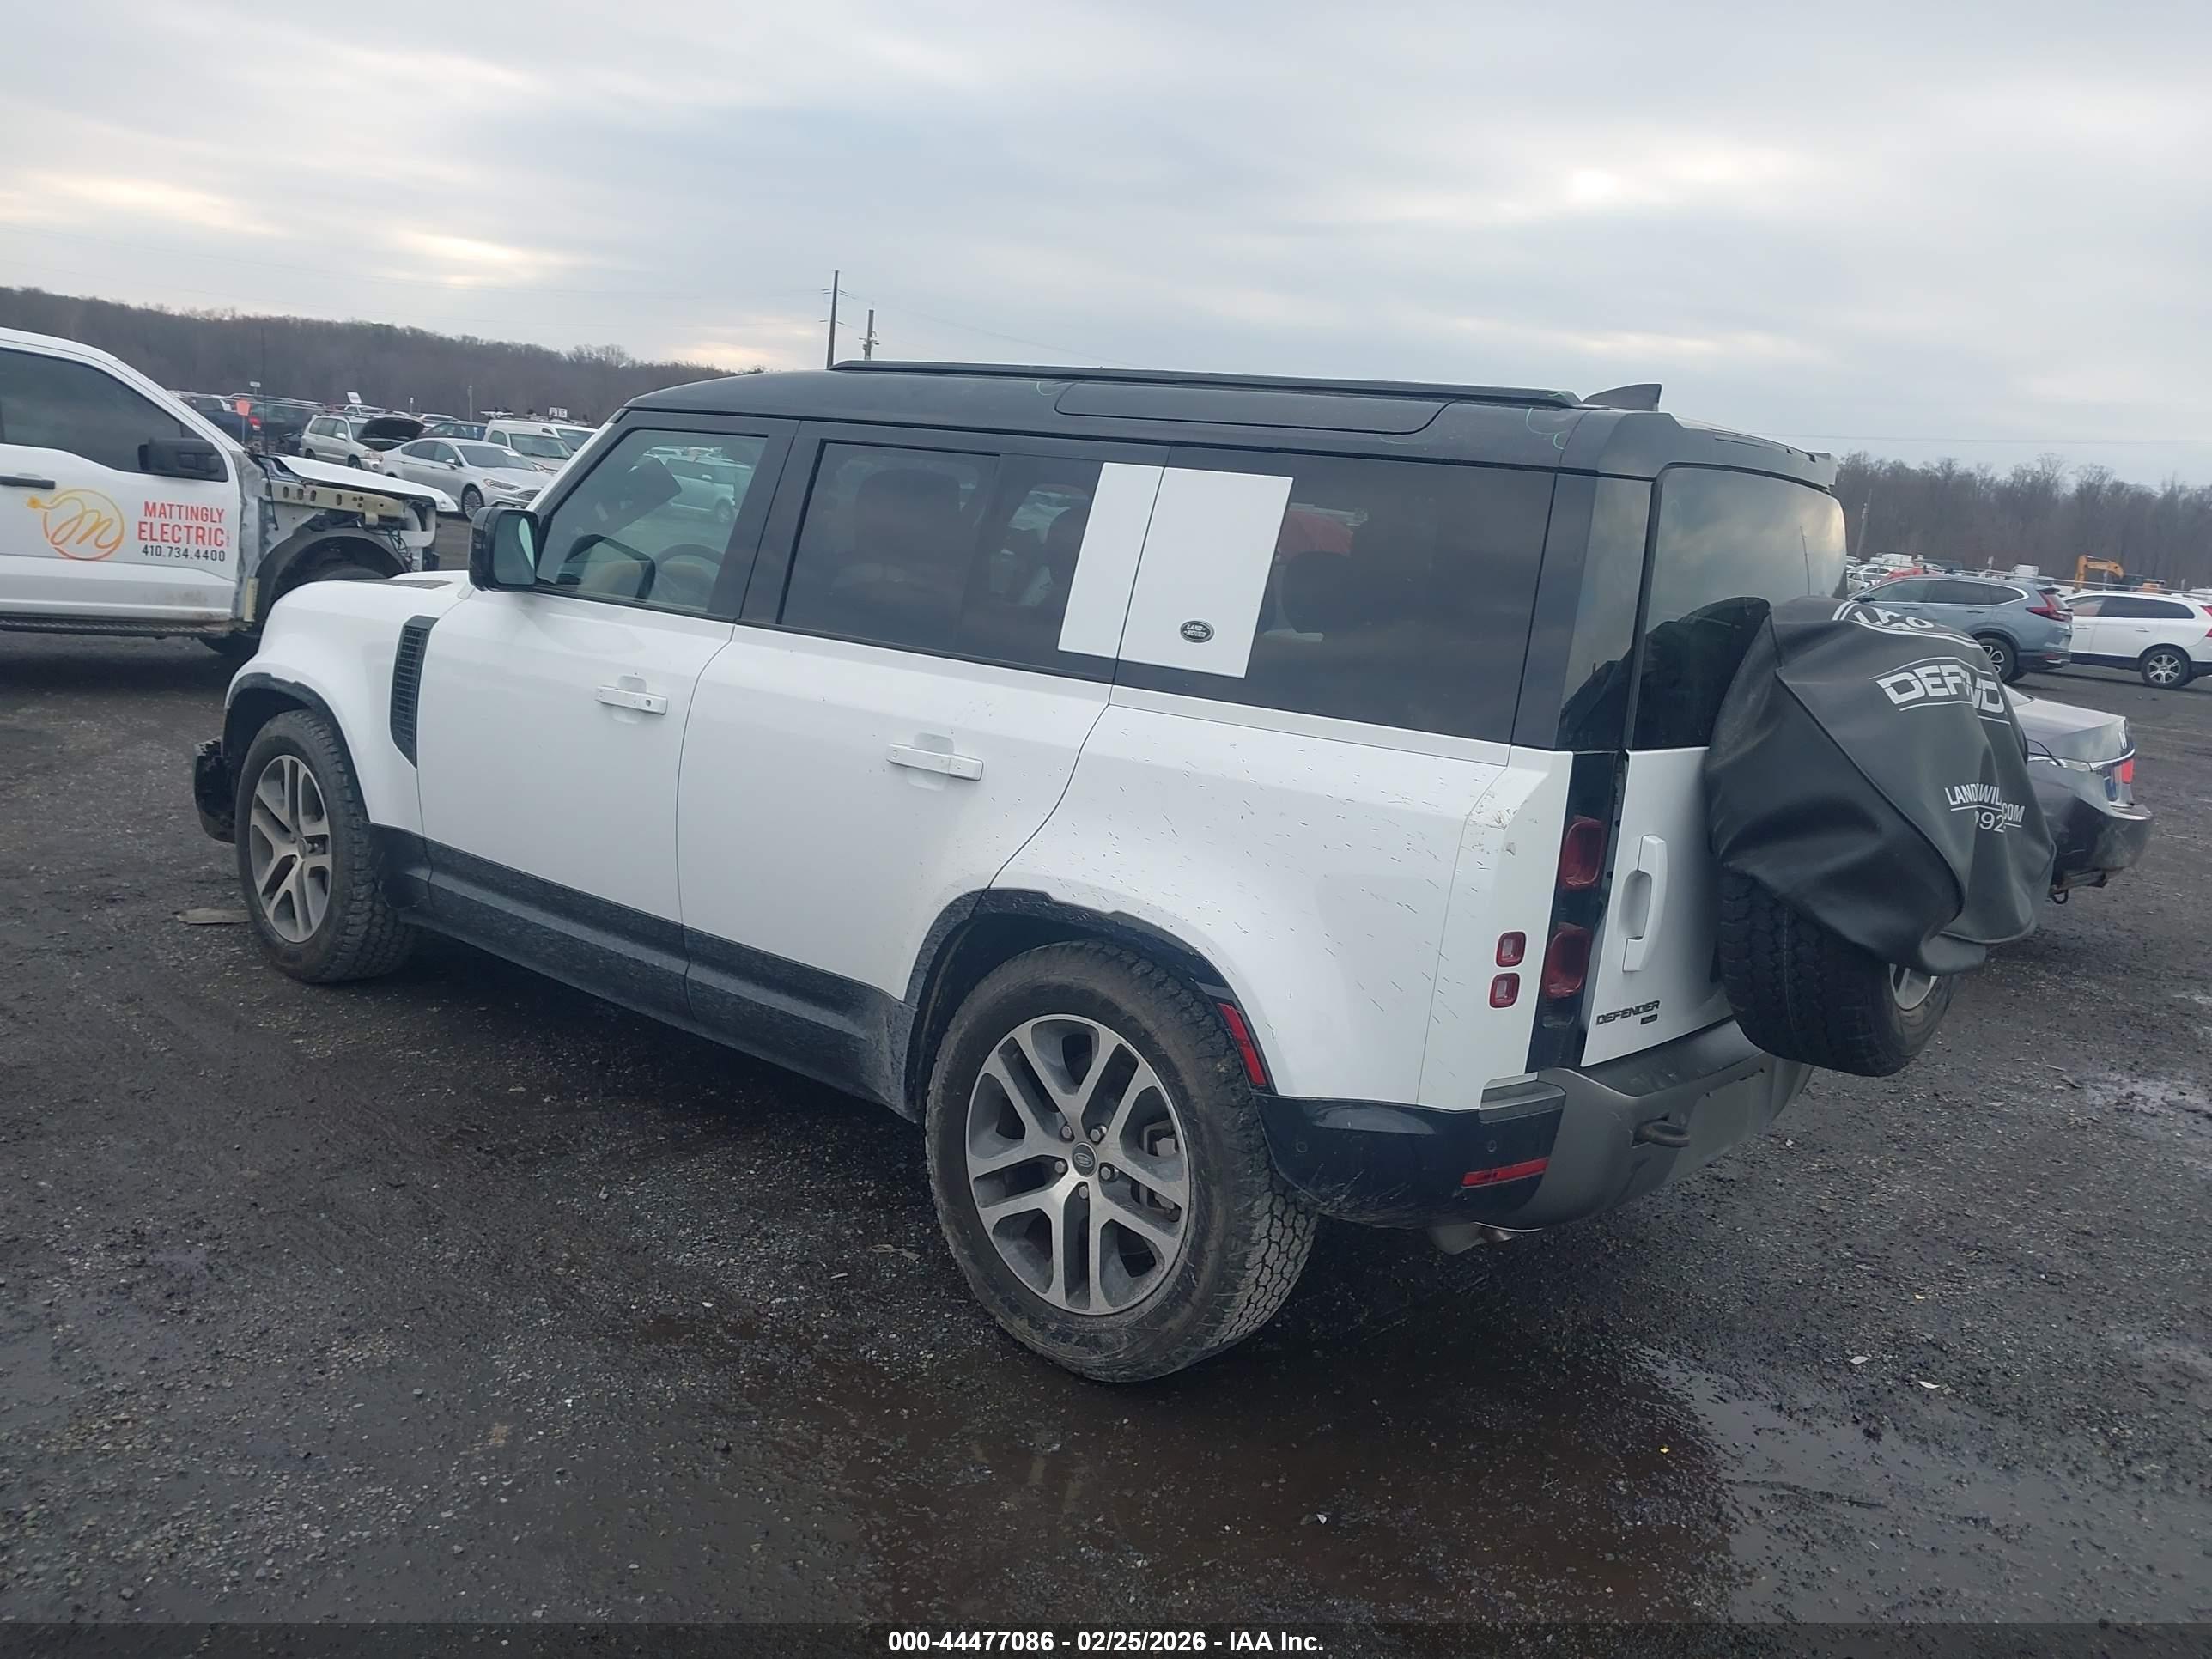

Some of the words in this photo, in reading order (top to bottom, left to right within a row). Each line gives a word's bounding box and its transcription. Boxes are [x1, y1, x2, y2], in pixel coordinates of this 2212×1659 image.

[143, 501, 225, 524] MATTINGLY
[137, 521, 225, 548] ELECTRIC
[142, 544, 225, 562] 410.734.4400
[1596, 1000, 1660, 1025] DEFENDER
